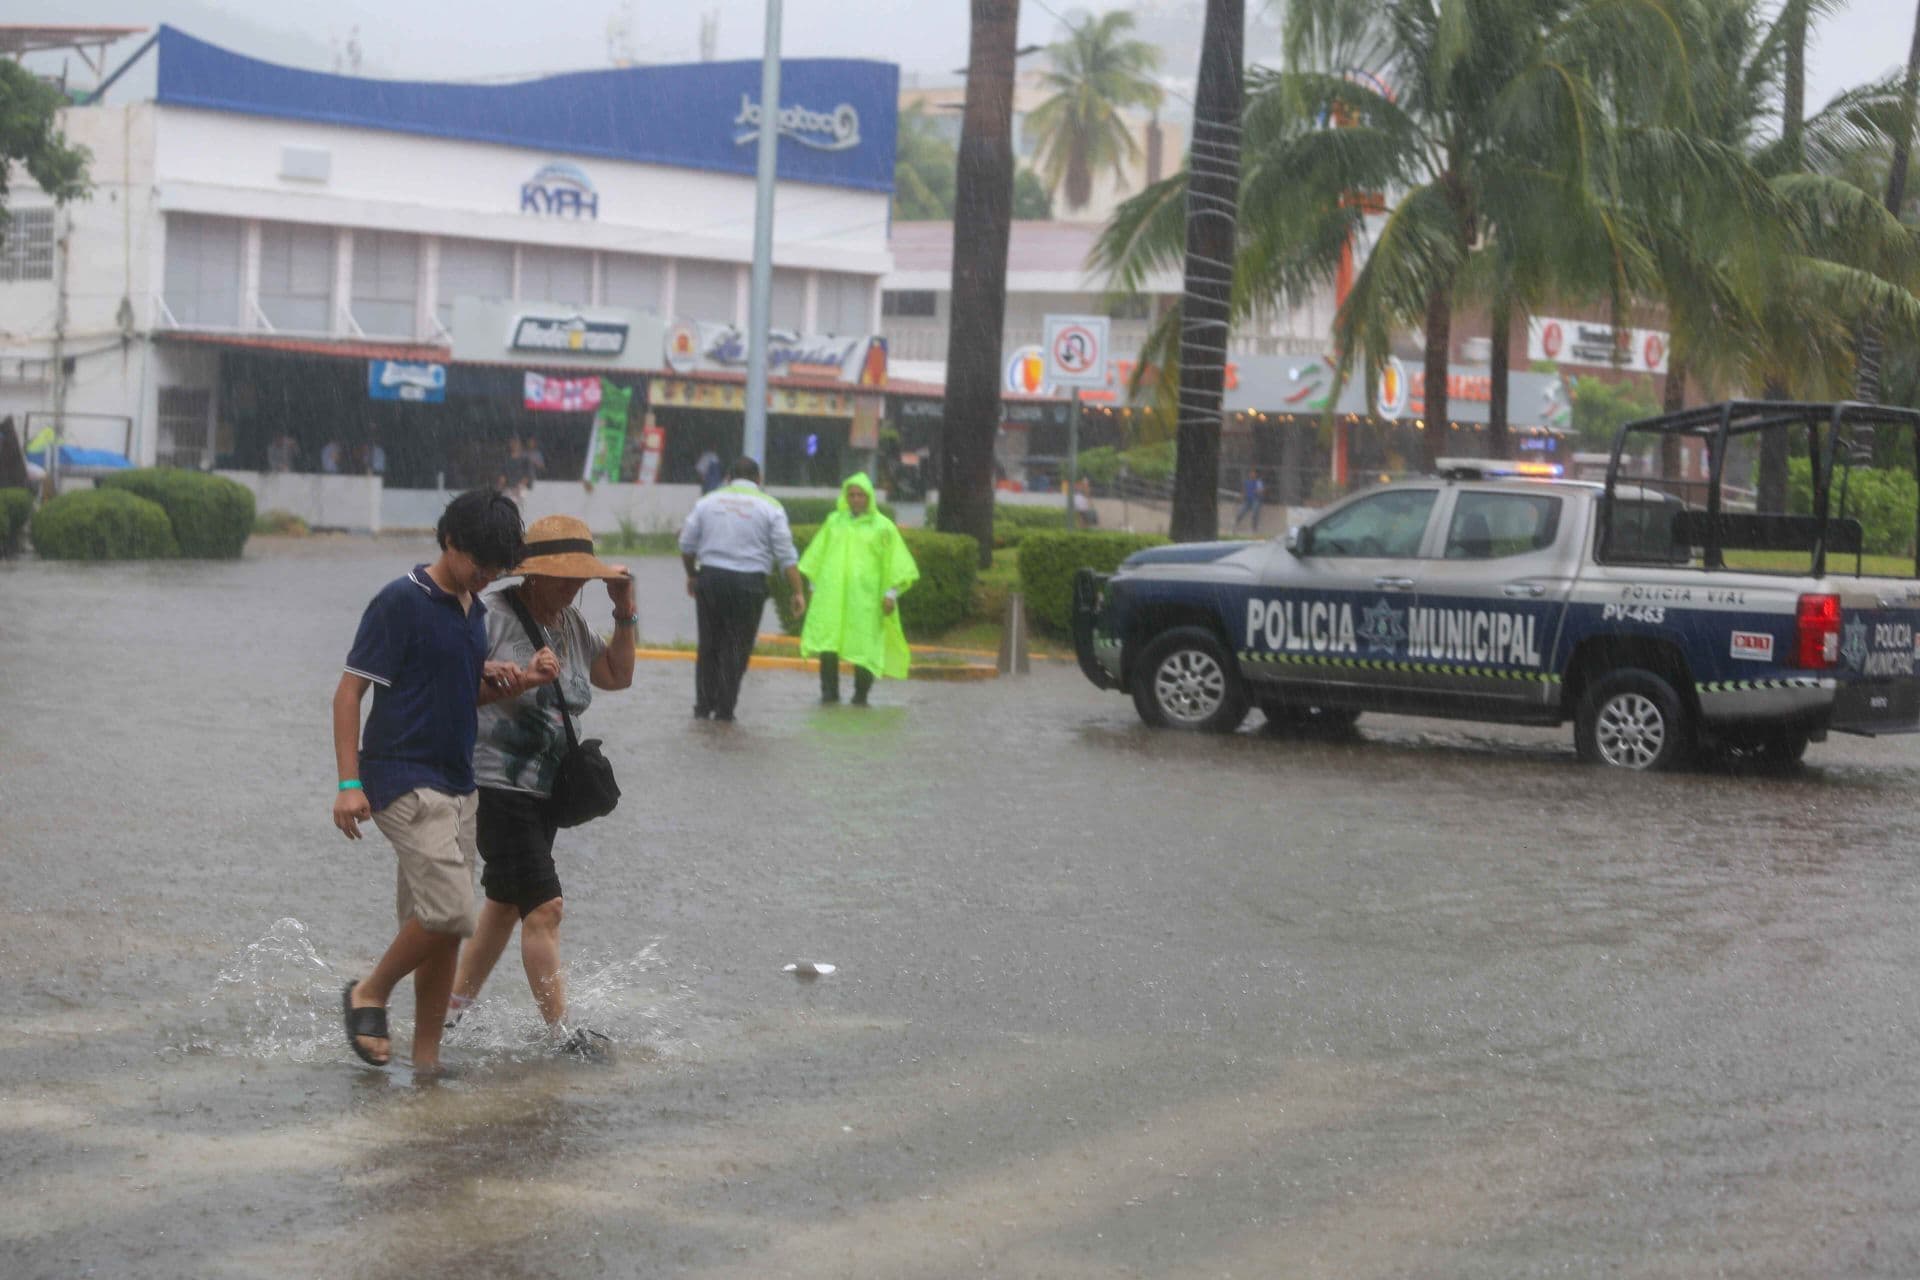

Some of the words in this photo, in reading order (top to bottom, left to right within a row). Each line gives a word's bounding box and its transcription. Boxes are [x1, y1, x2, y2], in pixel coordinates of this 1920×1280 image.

[1621, 585, 1692, 601] POLICIA
[1707, 590, 1746, 605] VIAL
[1602, 603, 1666, 624] PV-463
[1247, 598, 1357, 652] POLICIA
[1407, 606, 1541, 666] MUNICIPAL
[1874, 622, 1912, 649] POLICIA
